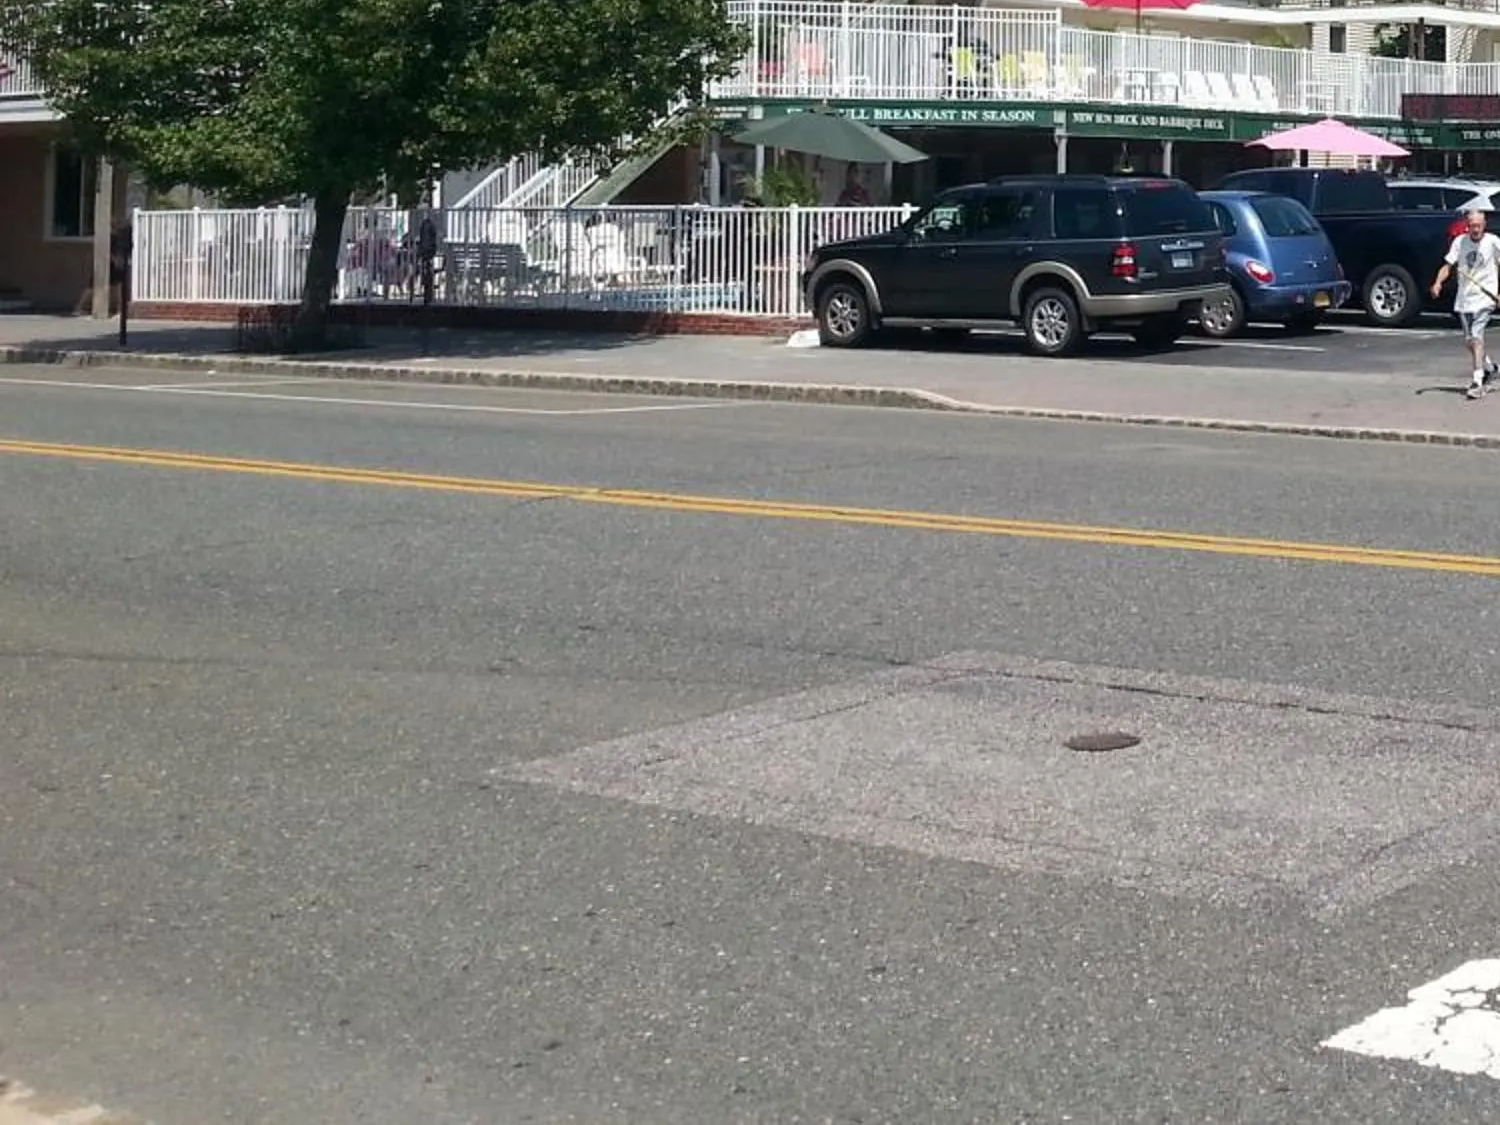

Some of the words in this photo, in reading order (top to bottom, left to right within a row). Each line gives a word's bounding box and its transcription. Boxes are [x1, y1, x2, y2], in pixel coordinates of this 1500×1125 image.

[873, 108, 958, 120] BREAKFAST
[961, 110, 977, 120] IN
[982, 110, 1036, 122] SEASON
[1072, 112, 1094, 123] NEW
[1140, 115, 1158, 126] AND
[1463, 130, 1481, 139] THE
